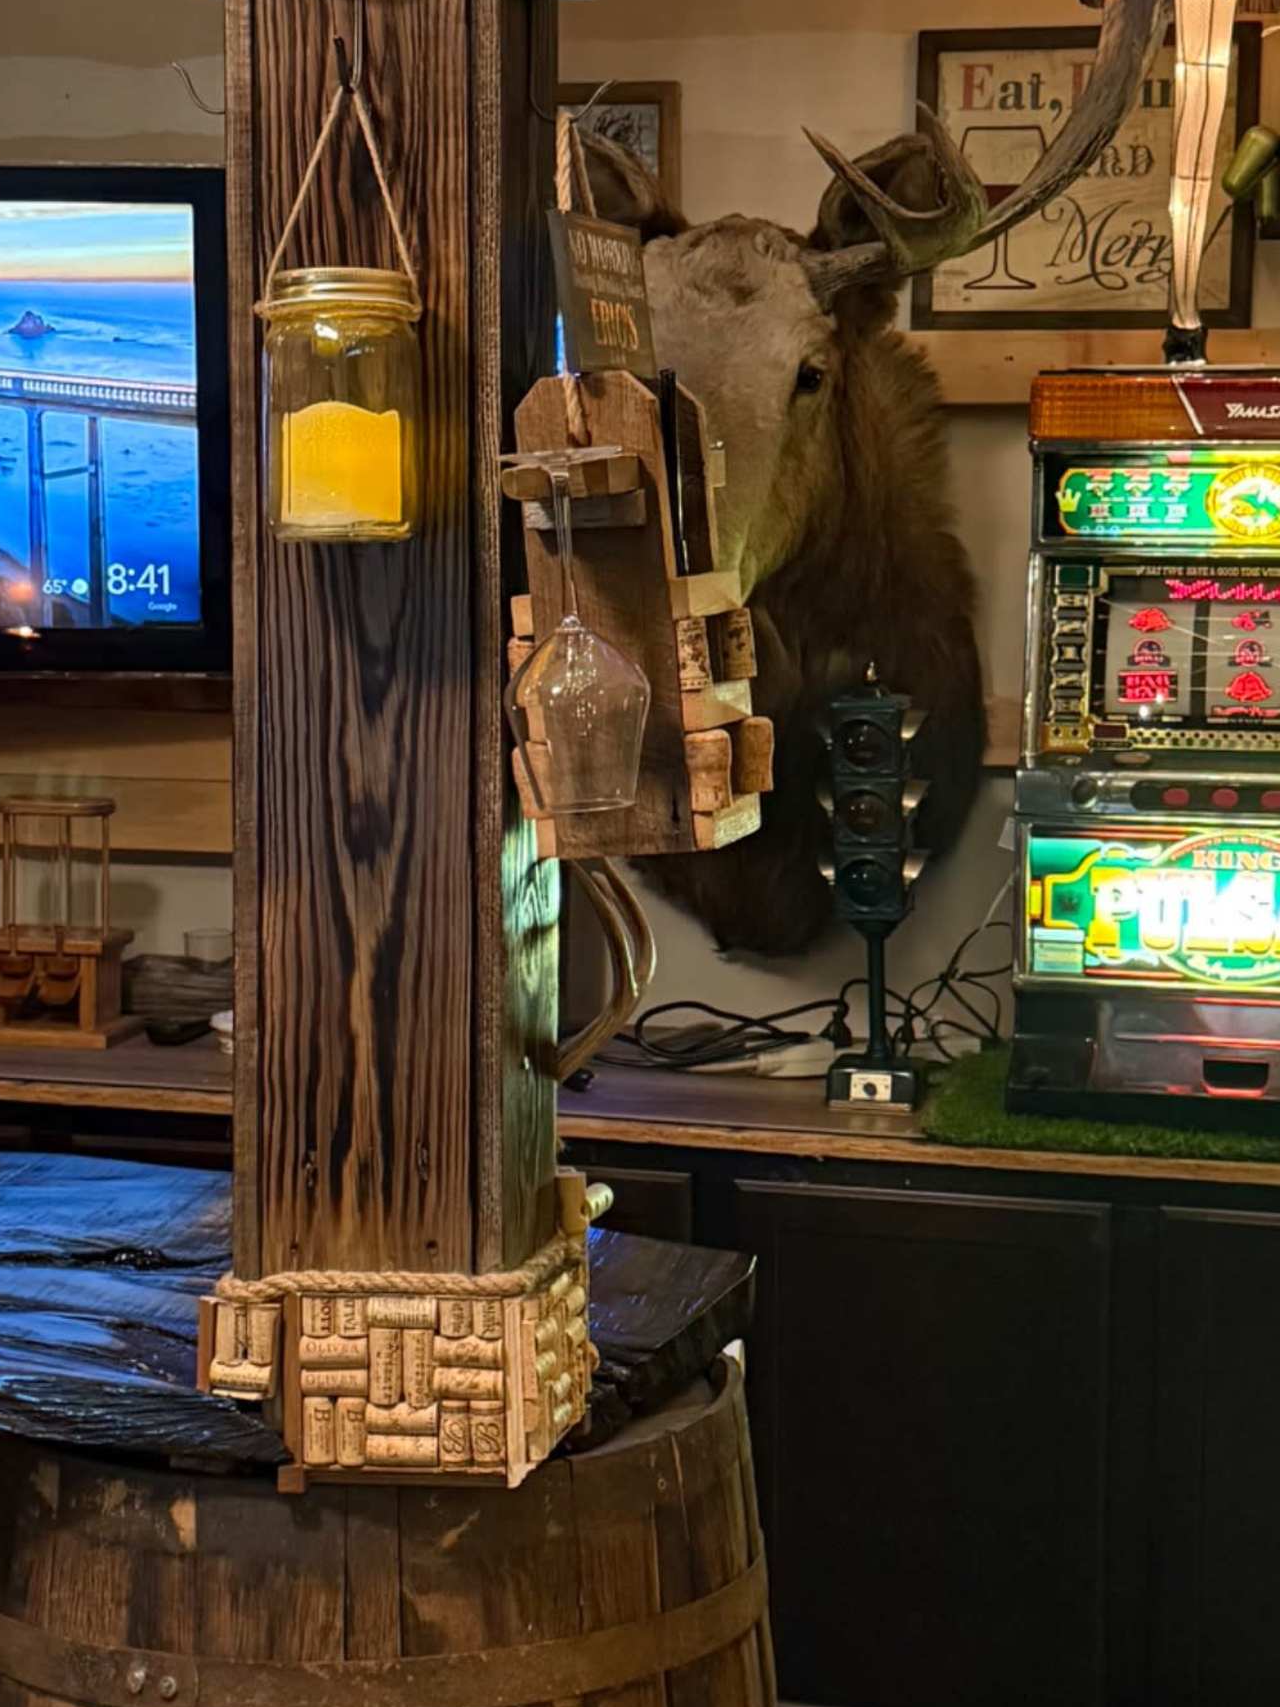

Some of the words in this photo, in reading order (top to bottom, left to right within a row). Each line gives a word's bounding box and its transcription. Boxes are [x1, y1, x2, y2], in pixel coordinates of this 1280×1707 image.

[959, 62, 1064, 124] Eat,
[42, 578, 68, 595] 65°
[106, 562, 171, 596] 8:41
[147, 601, 178, 612] Google
